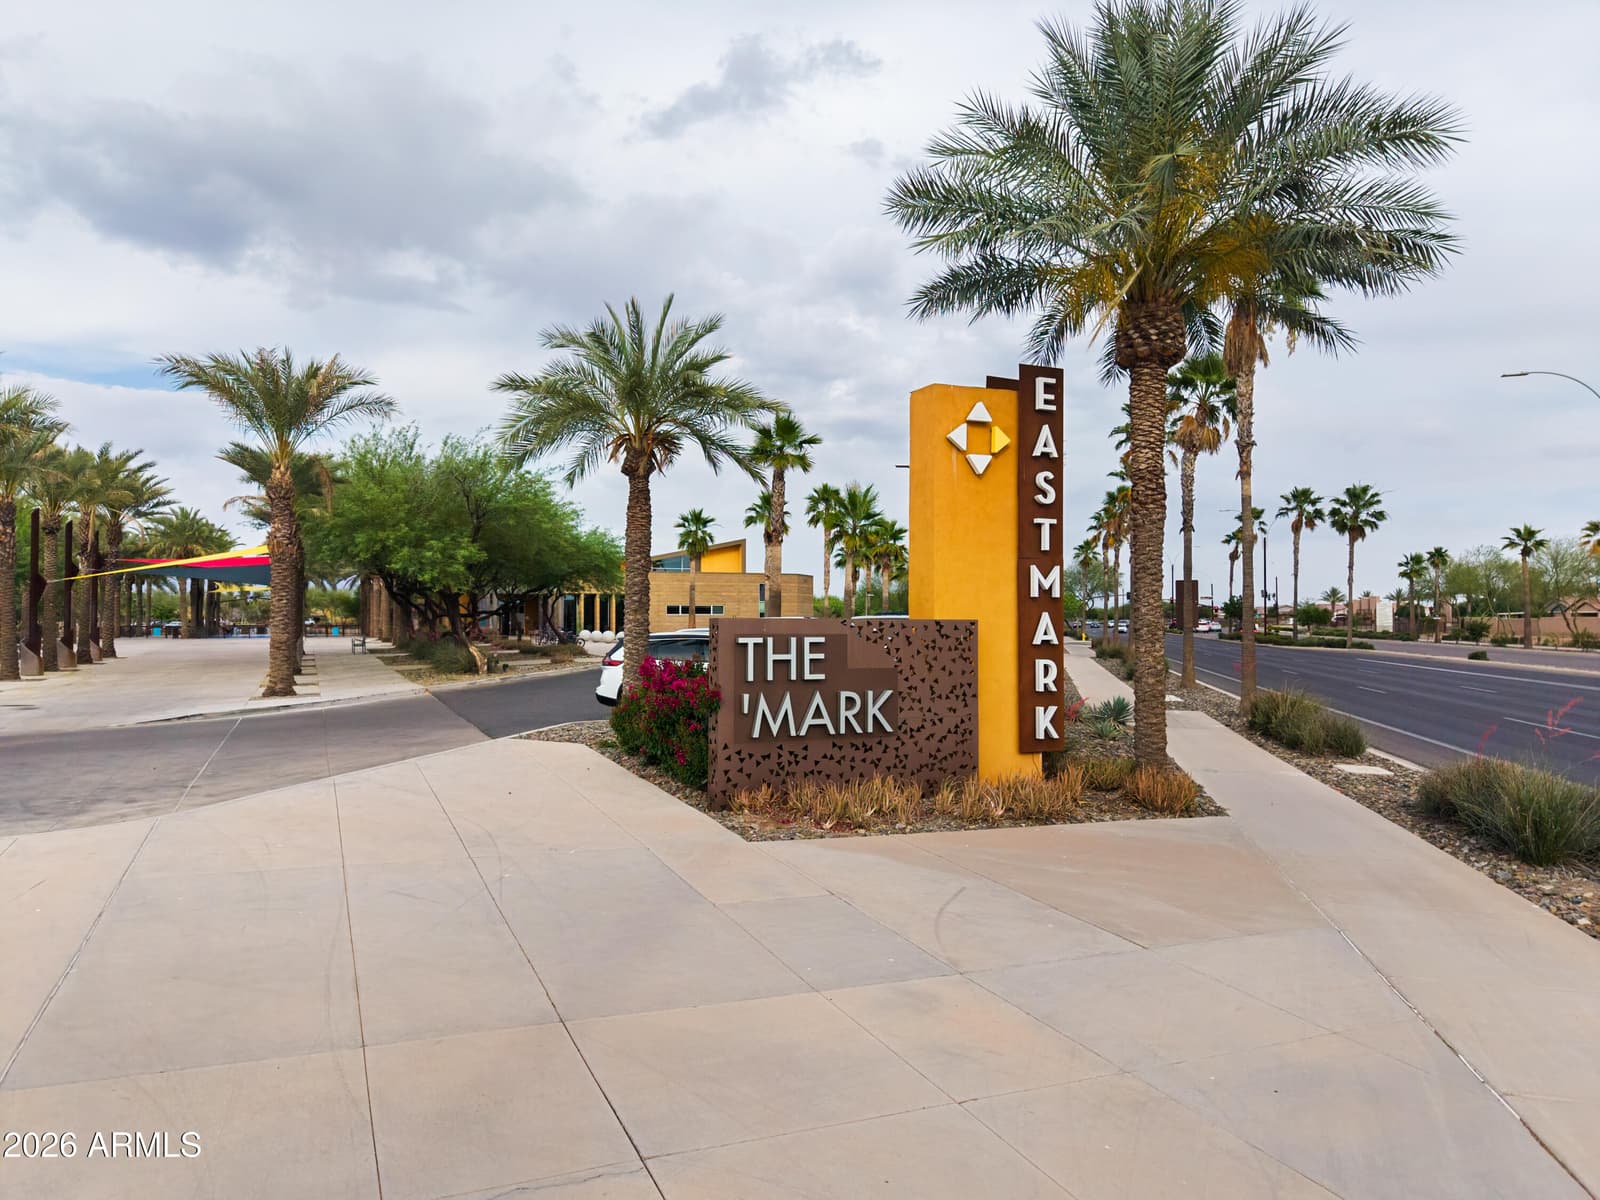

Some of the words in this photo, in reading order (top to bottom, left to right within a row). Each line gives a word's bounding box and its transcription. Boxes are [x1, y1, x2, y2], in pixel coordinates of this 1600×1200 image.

[1029, 376, 1061, 740] EASTMARK
[737, 636, 826, 682] THE
[742, 689, 894, 738] 'MARK
